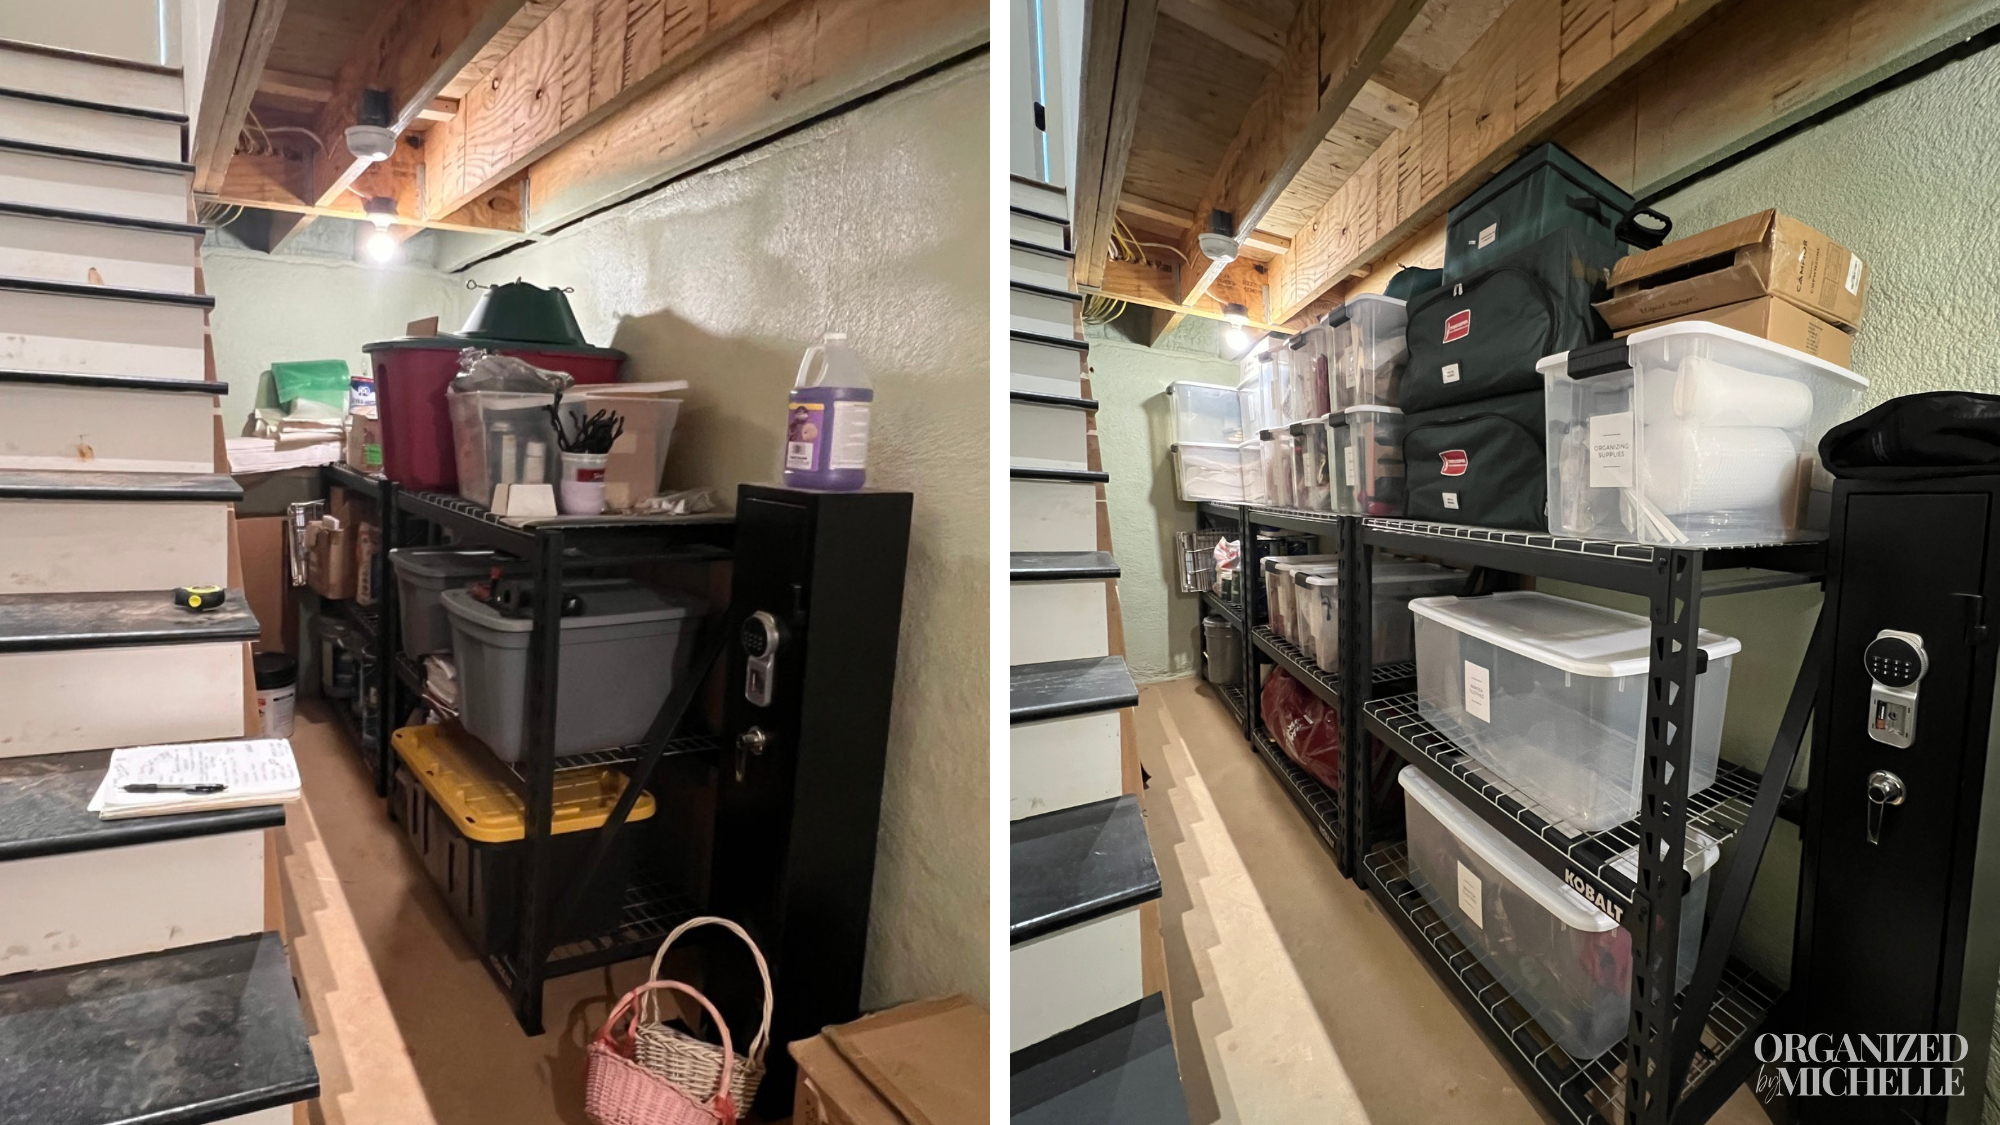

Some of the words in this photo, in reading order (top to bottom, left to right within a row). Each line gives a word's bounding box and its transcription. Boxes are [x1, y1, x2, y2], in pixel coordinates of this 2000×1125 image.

[1593, 443, 1630, 452] ORGANIZING
[1598, 451, 1625, 459] SUPPLIES
[1564, 868, 1624, 923] KOBALT
